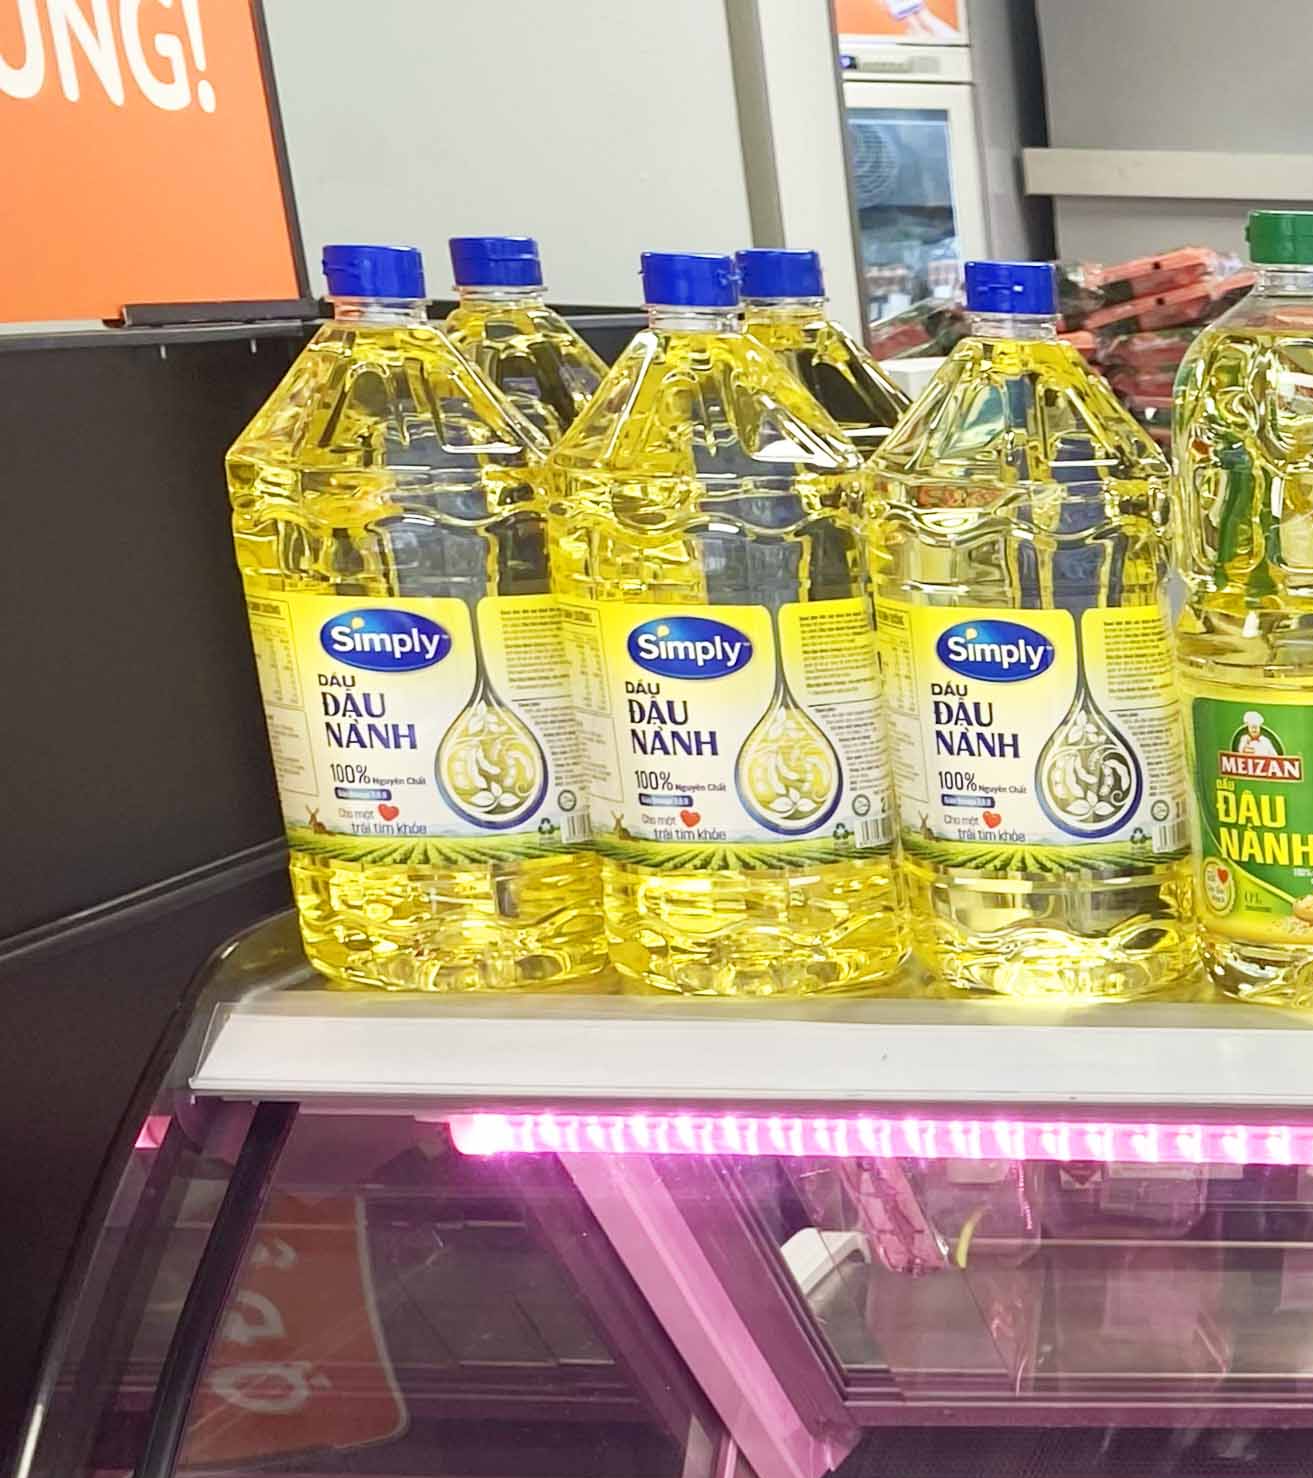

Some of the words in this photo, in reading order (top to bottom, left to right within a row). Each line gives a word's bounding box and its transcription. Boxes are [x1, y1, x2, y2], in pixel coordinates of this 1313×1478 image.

[331, 616, 440, 659] Simply
[637, 625, 743, 667] Simply
[947, 627, 1045, 670] Simply
[326, 714, 418, 750] NÀNH
[631, 722, 719, 756] NÀNH
[935, 726, 1021, 759] NÀNH
[938, 771, 977, 792] 100%
[1220, 756, 1301, 780] MEIZAN
